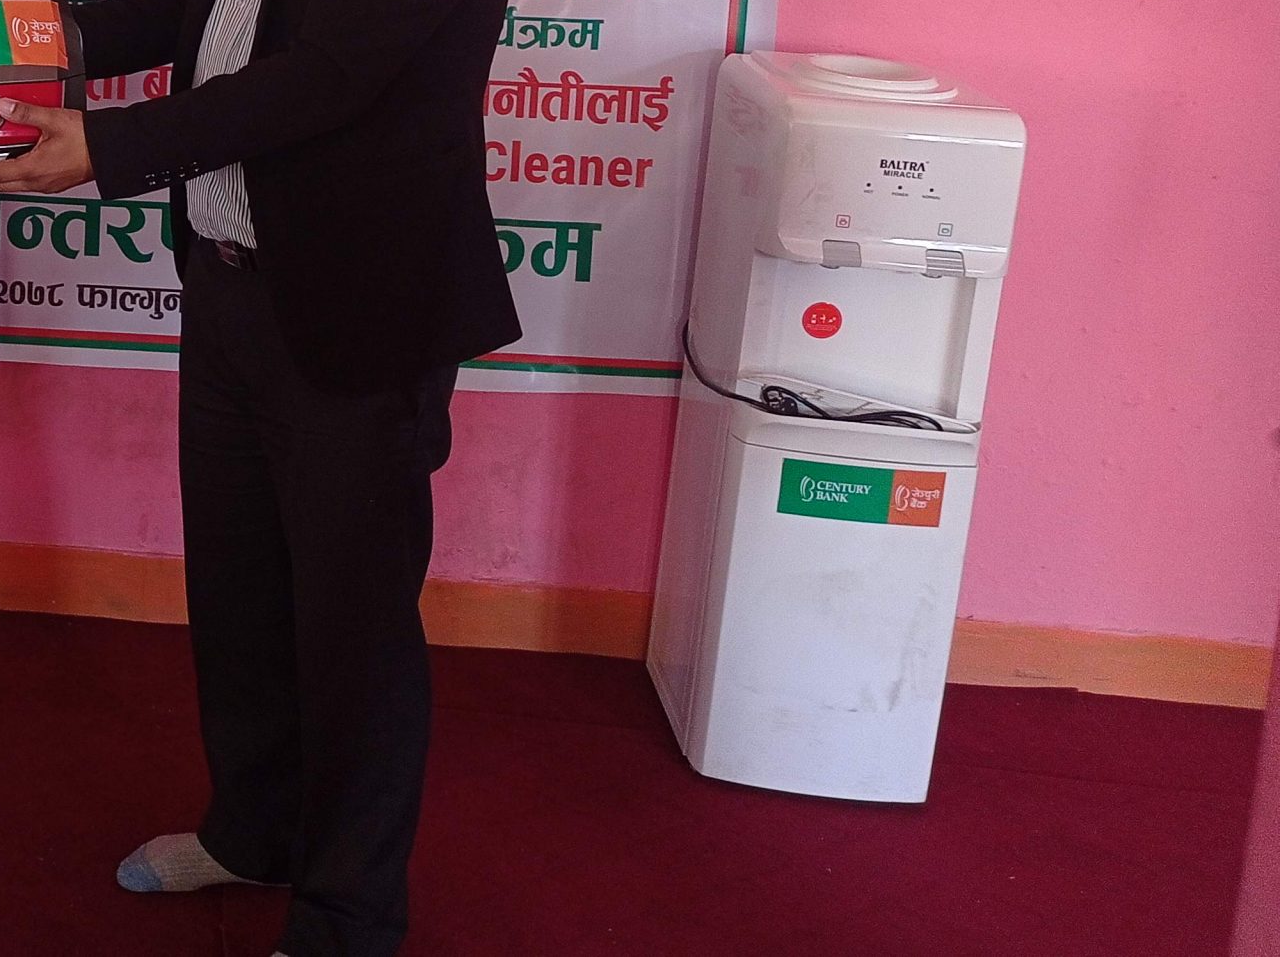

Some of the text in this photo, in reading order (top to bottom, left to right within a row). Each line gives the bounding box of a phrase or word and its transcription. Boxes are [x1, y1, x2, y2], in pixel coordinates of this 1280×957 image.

[483, 66, 675, 132] नौतीलाई
[485, 140, 654, 189] Cleaner
[880, 159, 926, 172] BALTRA
[883, 170, 924, 180] MIRACLE
[816, 480, 873, 495] CENTURY
[816, 491, 849, 503] BANK
